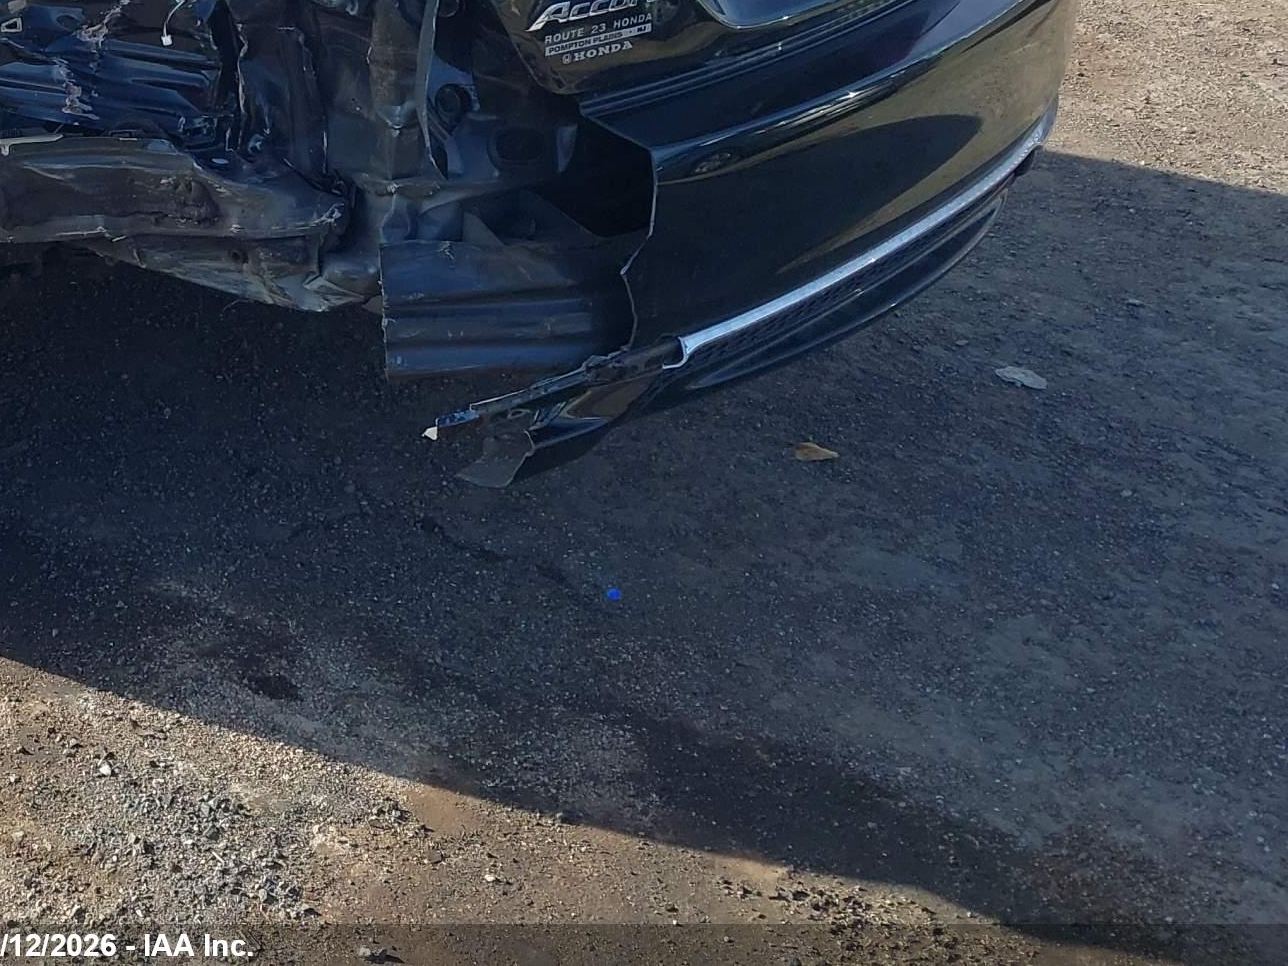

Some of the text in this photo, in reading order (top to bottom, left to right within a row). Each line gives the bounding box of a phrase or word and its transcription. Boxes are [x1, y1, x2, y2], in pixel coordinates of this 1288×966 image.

[544, 12, 653, 46] ROUTE 23 HONDA
[548, 37, 592, 54] POMPTON
[573, 40, 633, 62] HONDA
